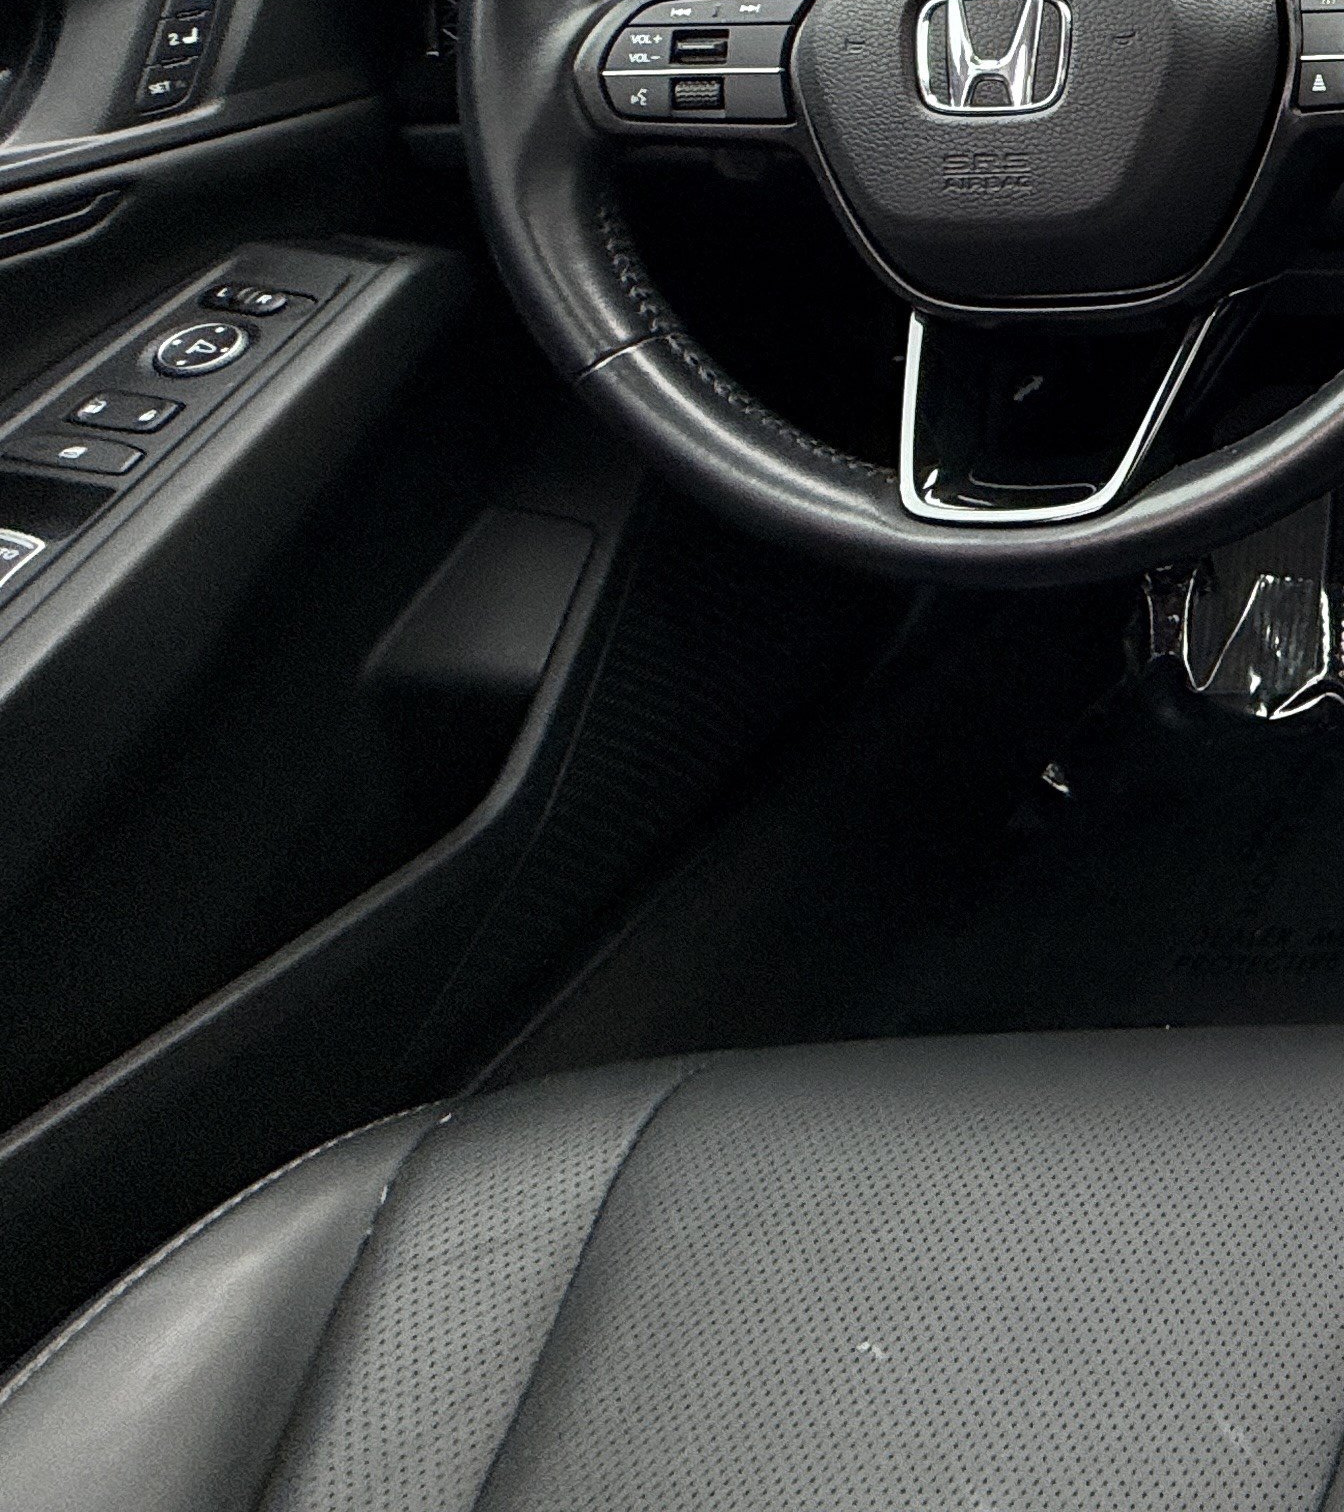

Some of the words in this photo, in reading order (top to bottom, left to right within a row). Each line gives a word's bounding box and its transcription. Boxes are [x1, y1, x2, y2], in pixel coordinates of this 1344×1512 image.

[168, 32, 180, 46] 2
[148, 80, 171, 94] SET
[255, 294, 273, 304] R
